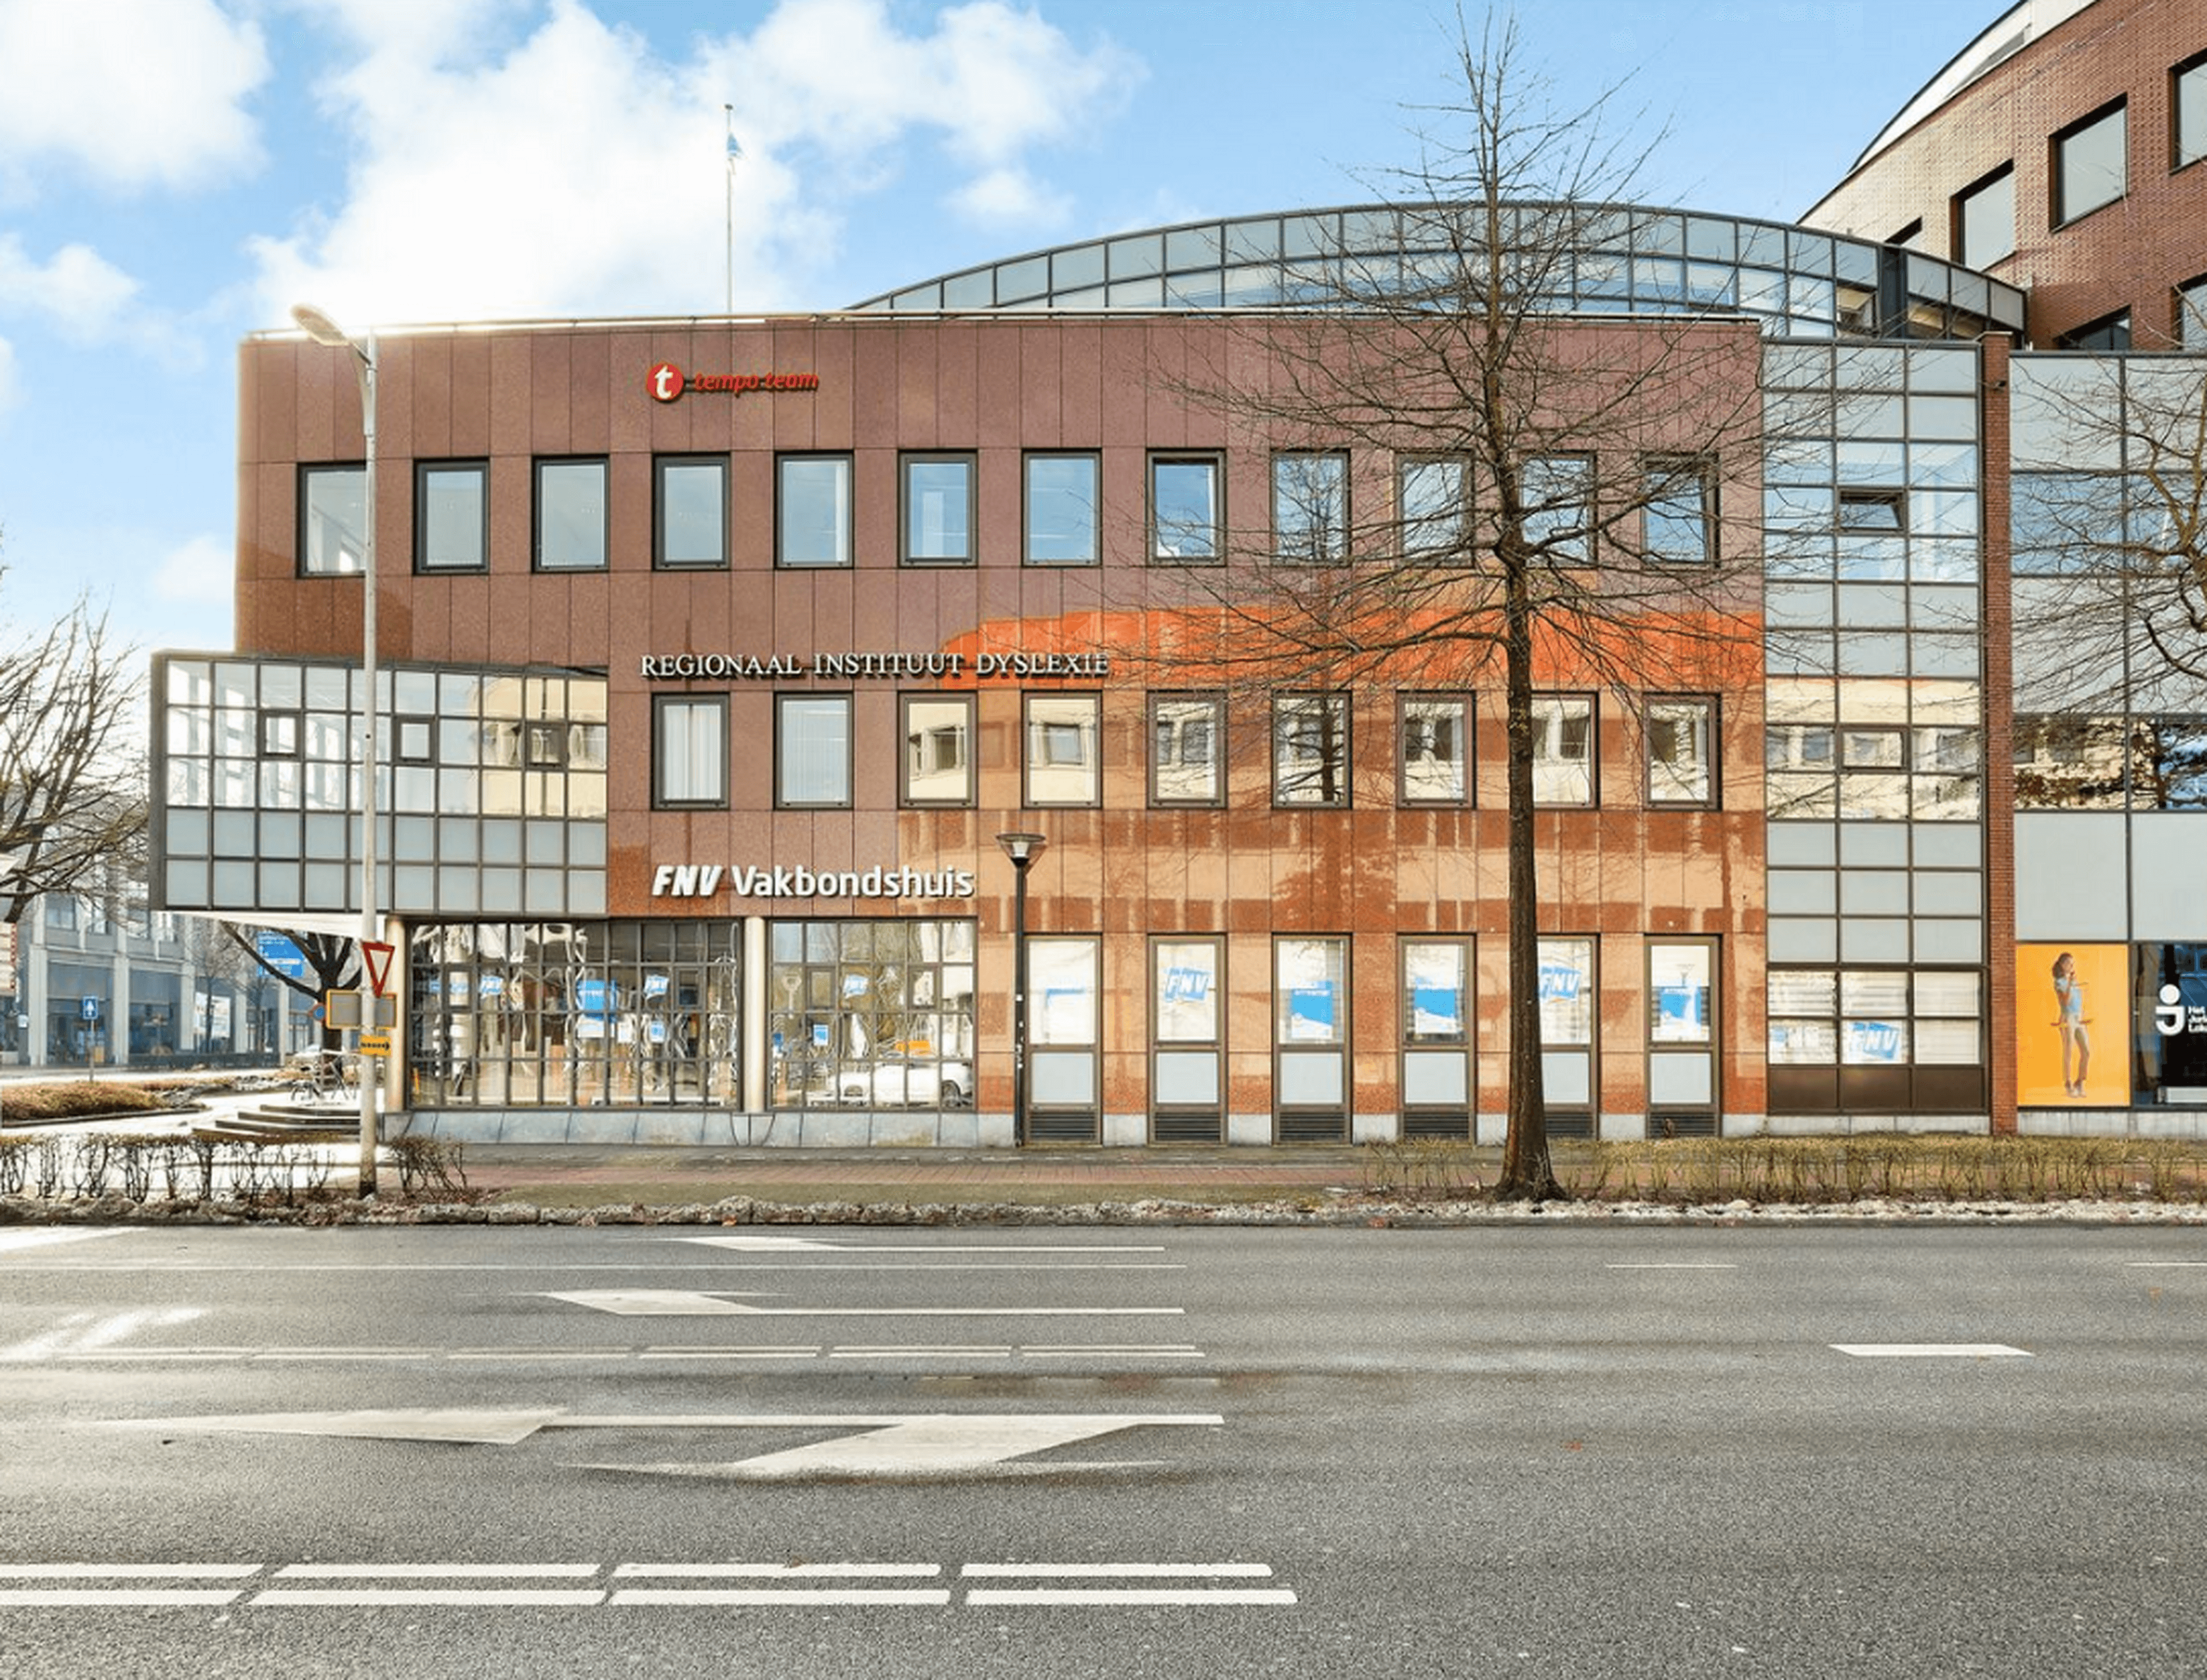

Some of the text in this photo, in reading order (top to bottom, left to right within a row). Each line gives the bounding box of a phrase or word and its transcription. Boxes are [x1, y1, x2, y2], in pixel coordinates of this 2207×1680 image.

[640, 653, 1109, 675] REGIONAAL INSTITUUT DYSLEXIE
[652, 864, 974, 897] FNV Vakbondshuis
